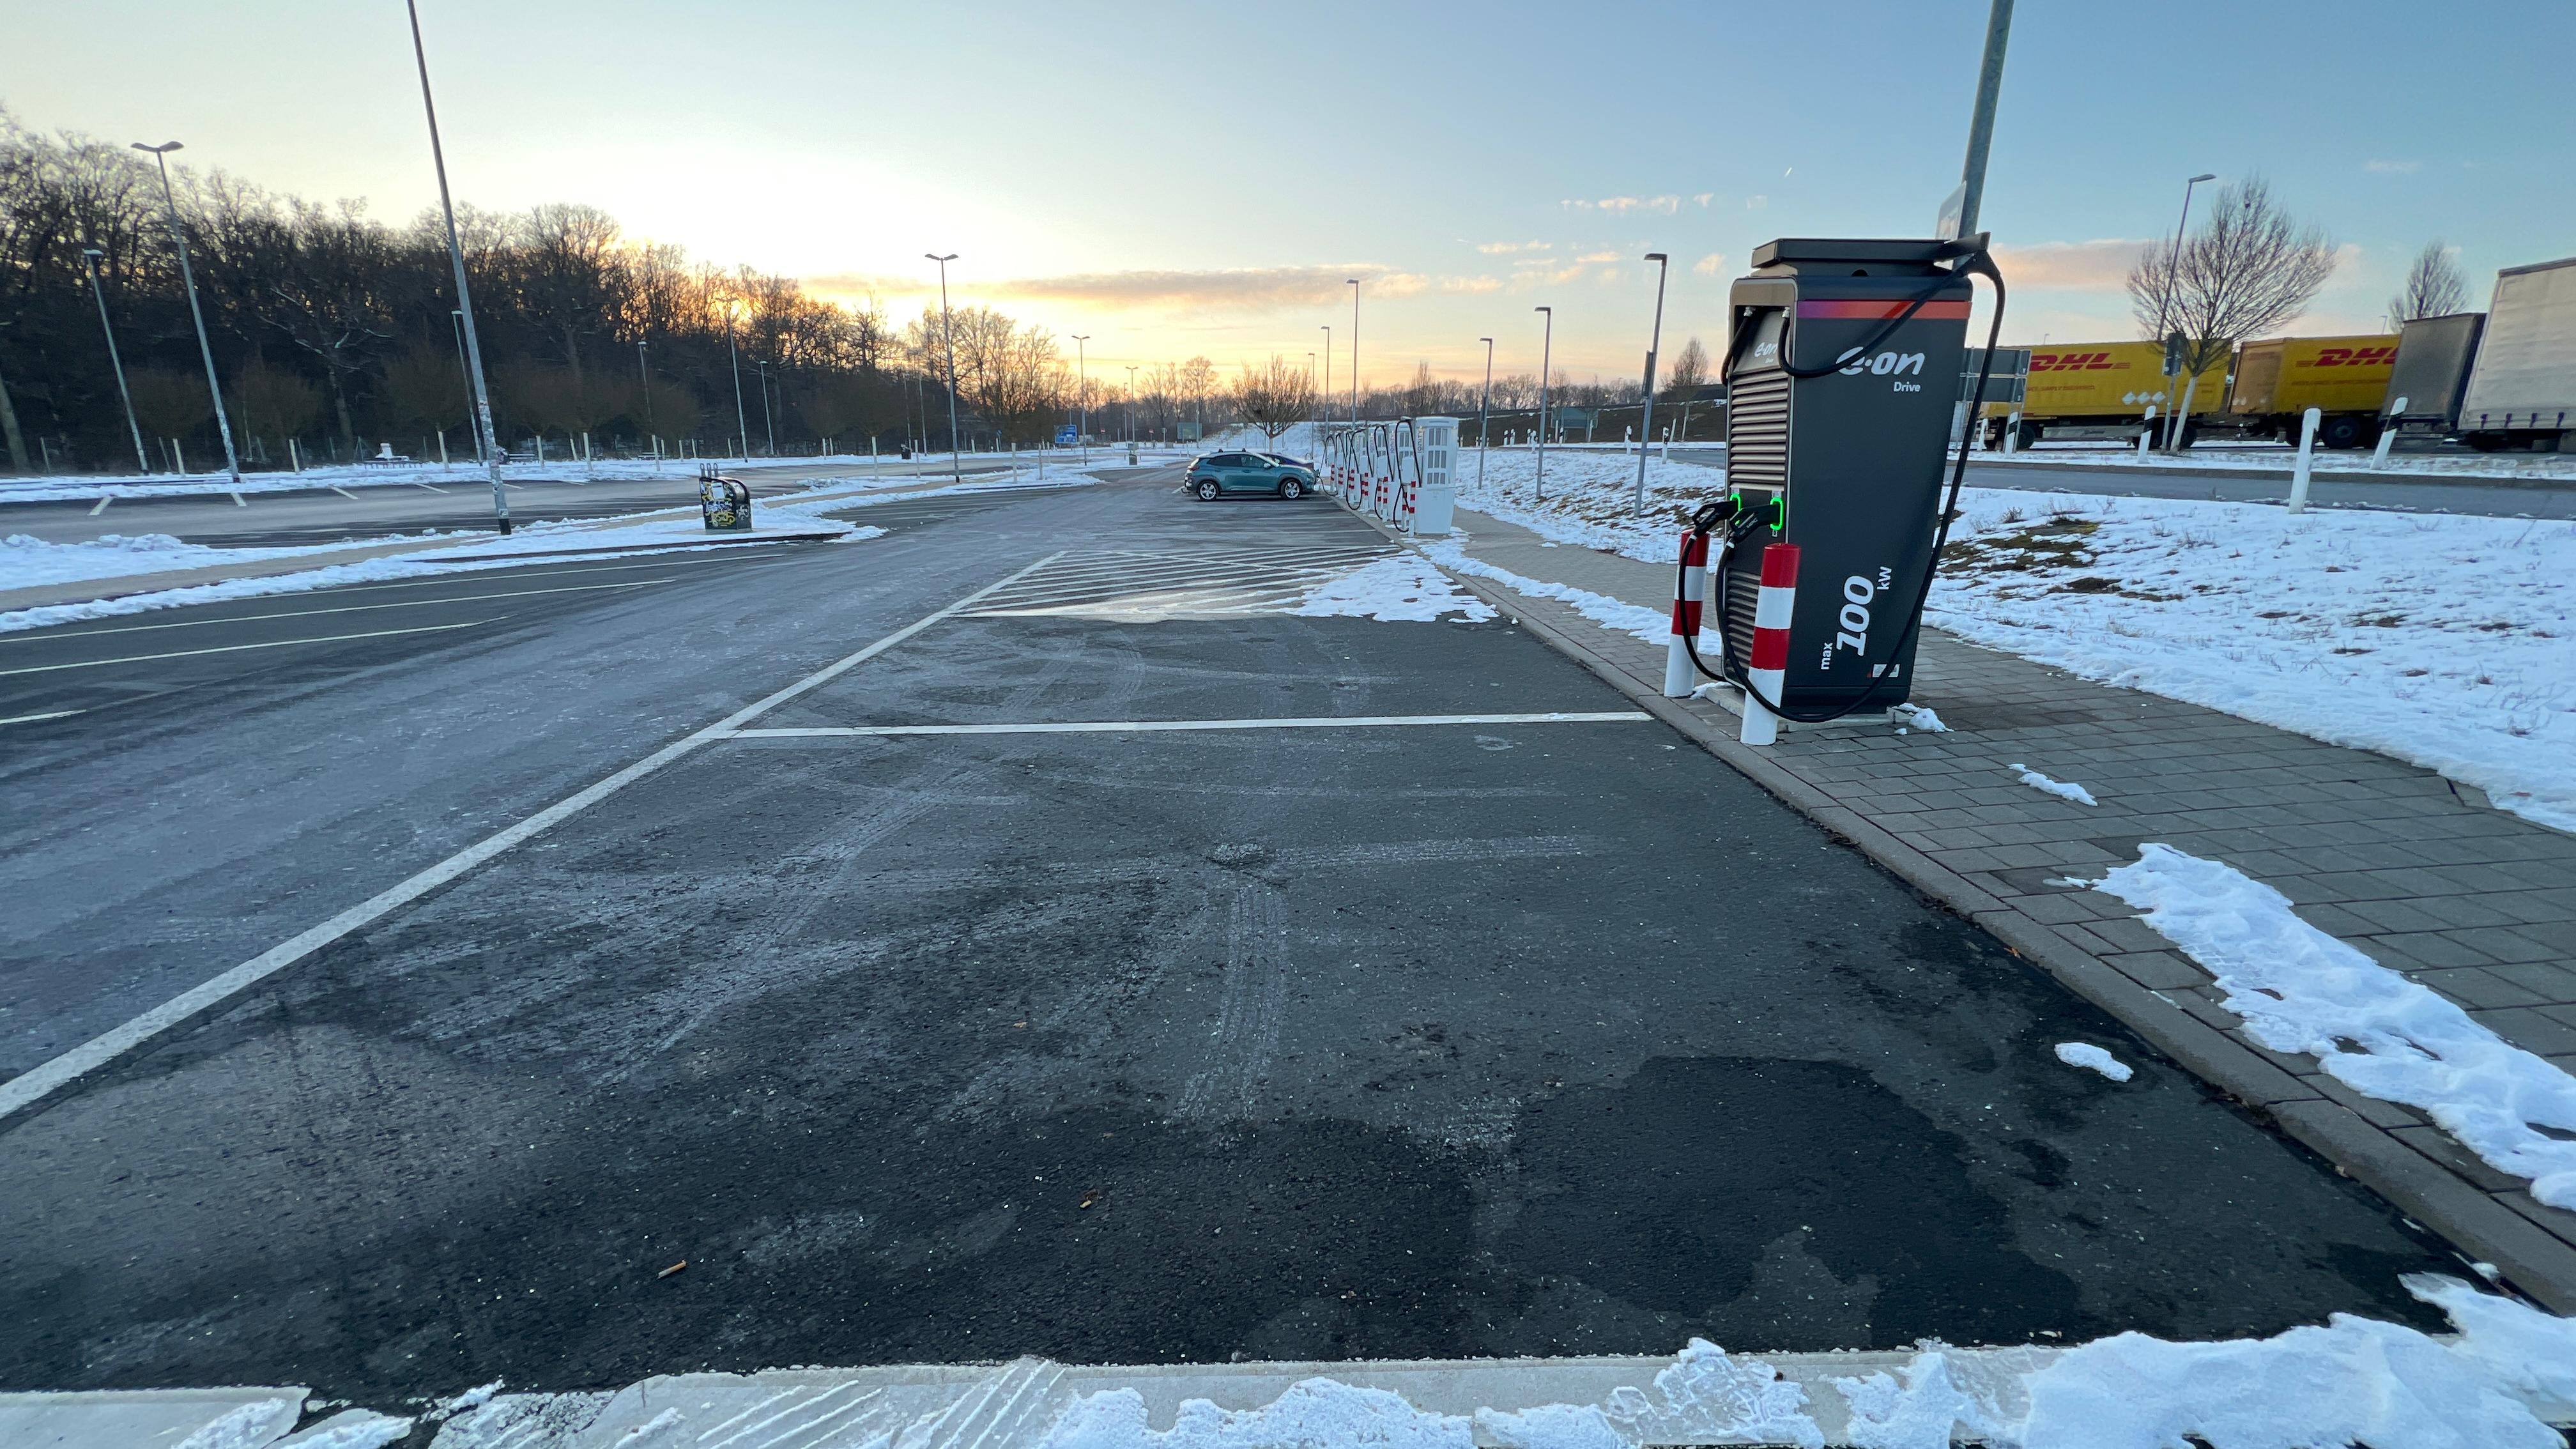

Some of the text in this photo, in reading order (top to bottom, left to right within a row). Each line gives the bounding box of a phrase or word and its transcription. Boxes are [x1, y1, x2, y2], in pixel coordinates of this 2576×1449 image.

[2029, 353, 2111, 371] DHL
[1893, 381, 1921, 392] Drive
[1821, 566, 1892, 670] max 100 kW
